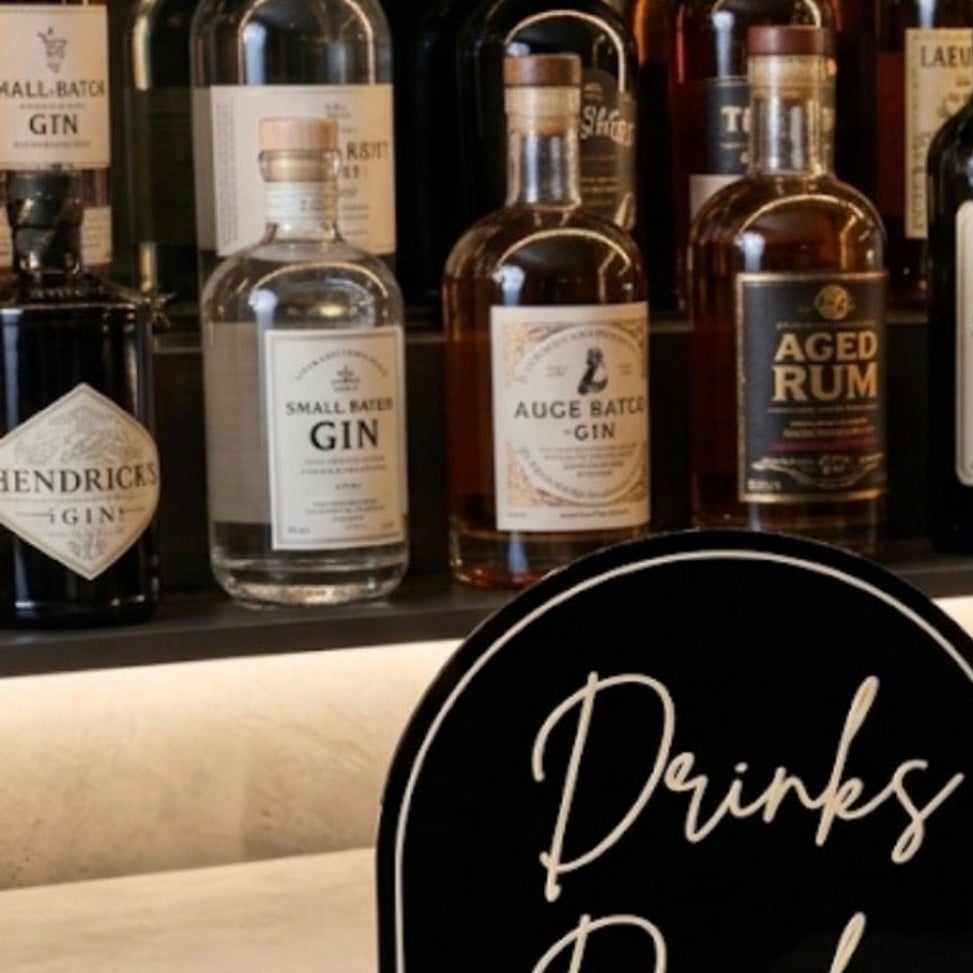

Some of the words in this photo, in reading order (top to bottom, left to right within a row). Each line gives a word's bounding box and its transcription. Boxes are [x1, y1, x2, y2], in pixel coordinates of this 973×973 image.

[774, 330, 879, 363] AGED
[771, 361, 879, 402] RUM
[285, 398, 346, 417] SMALL
[513, 401, 582, 420] AUGE
[309, 419, 379, 452] GIN
[532, 671, 964, 902] Drinks
